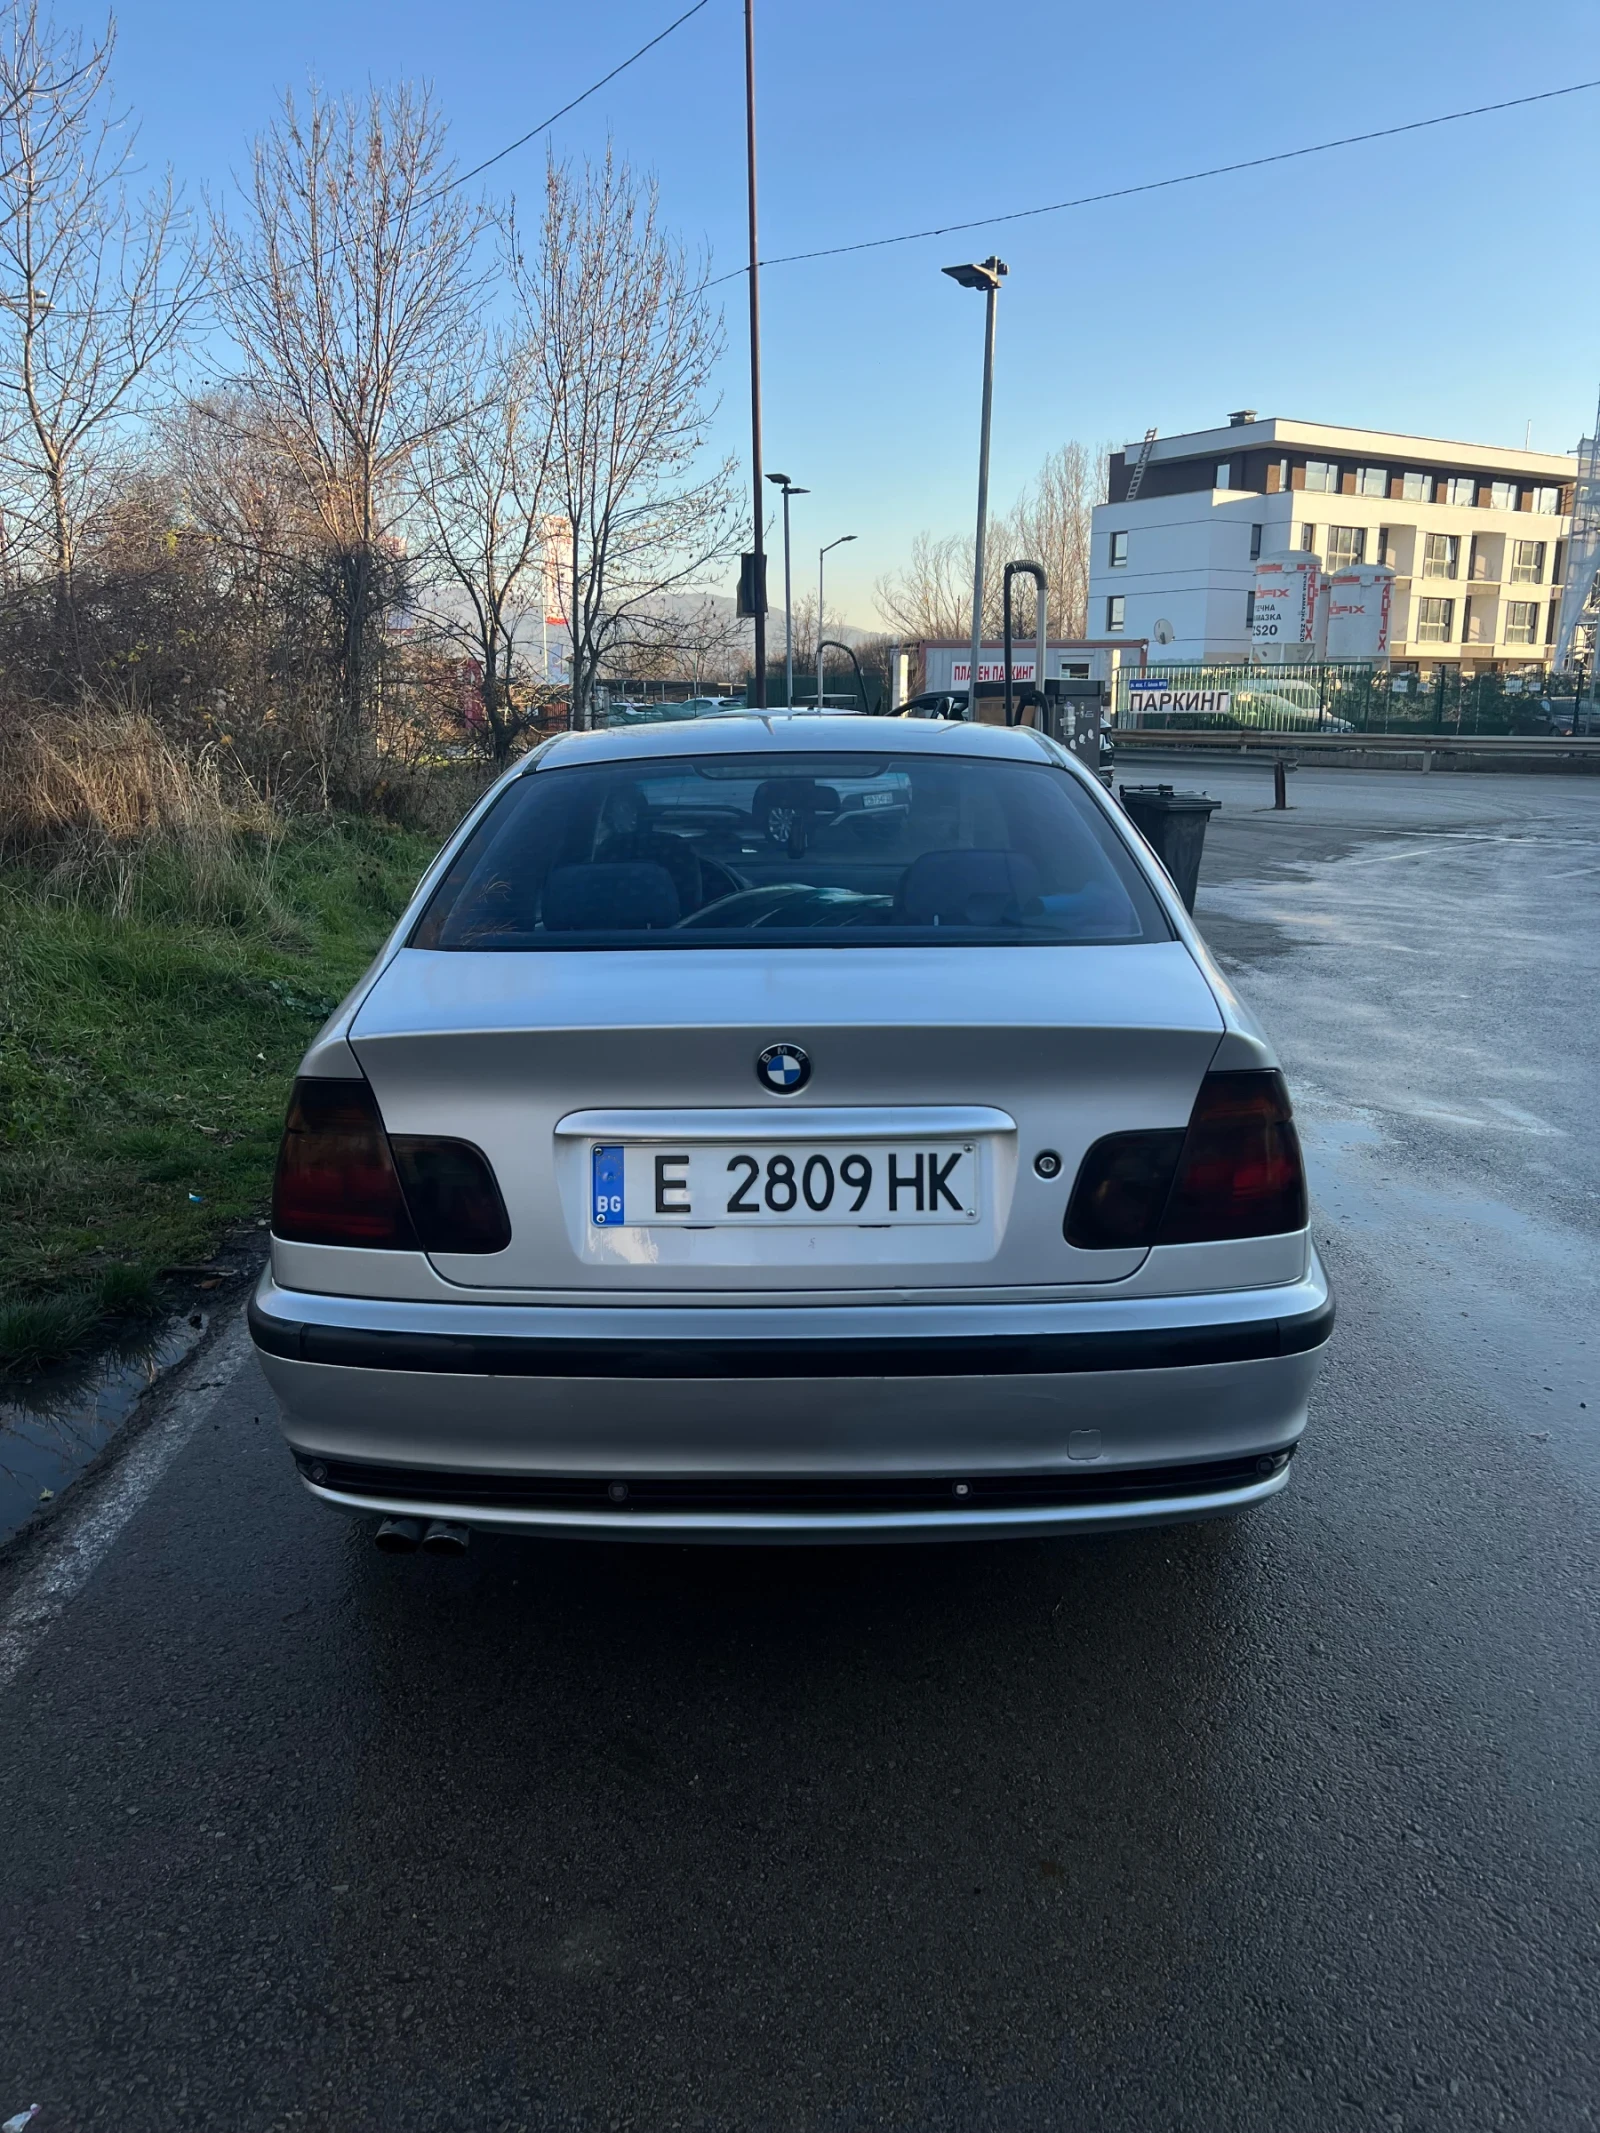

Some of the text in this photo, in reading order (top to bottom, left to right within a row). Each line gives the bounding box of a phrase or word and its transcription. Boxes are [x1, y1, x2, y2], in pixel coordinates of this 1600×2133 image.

[954, 665, 1034, 681] ПЛАЕН ПАКИНГ
[1129, 692, 1229, 712] ПАРКИНГ
[761, 1046, 806, 1064] BMW
[654, 1152, 965, 1214] E 2809 HK
[597, 1195, 621, 1212] BG
